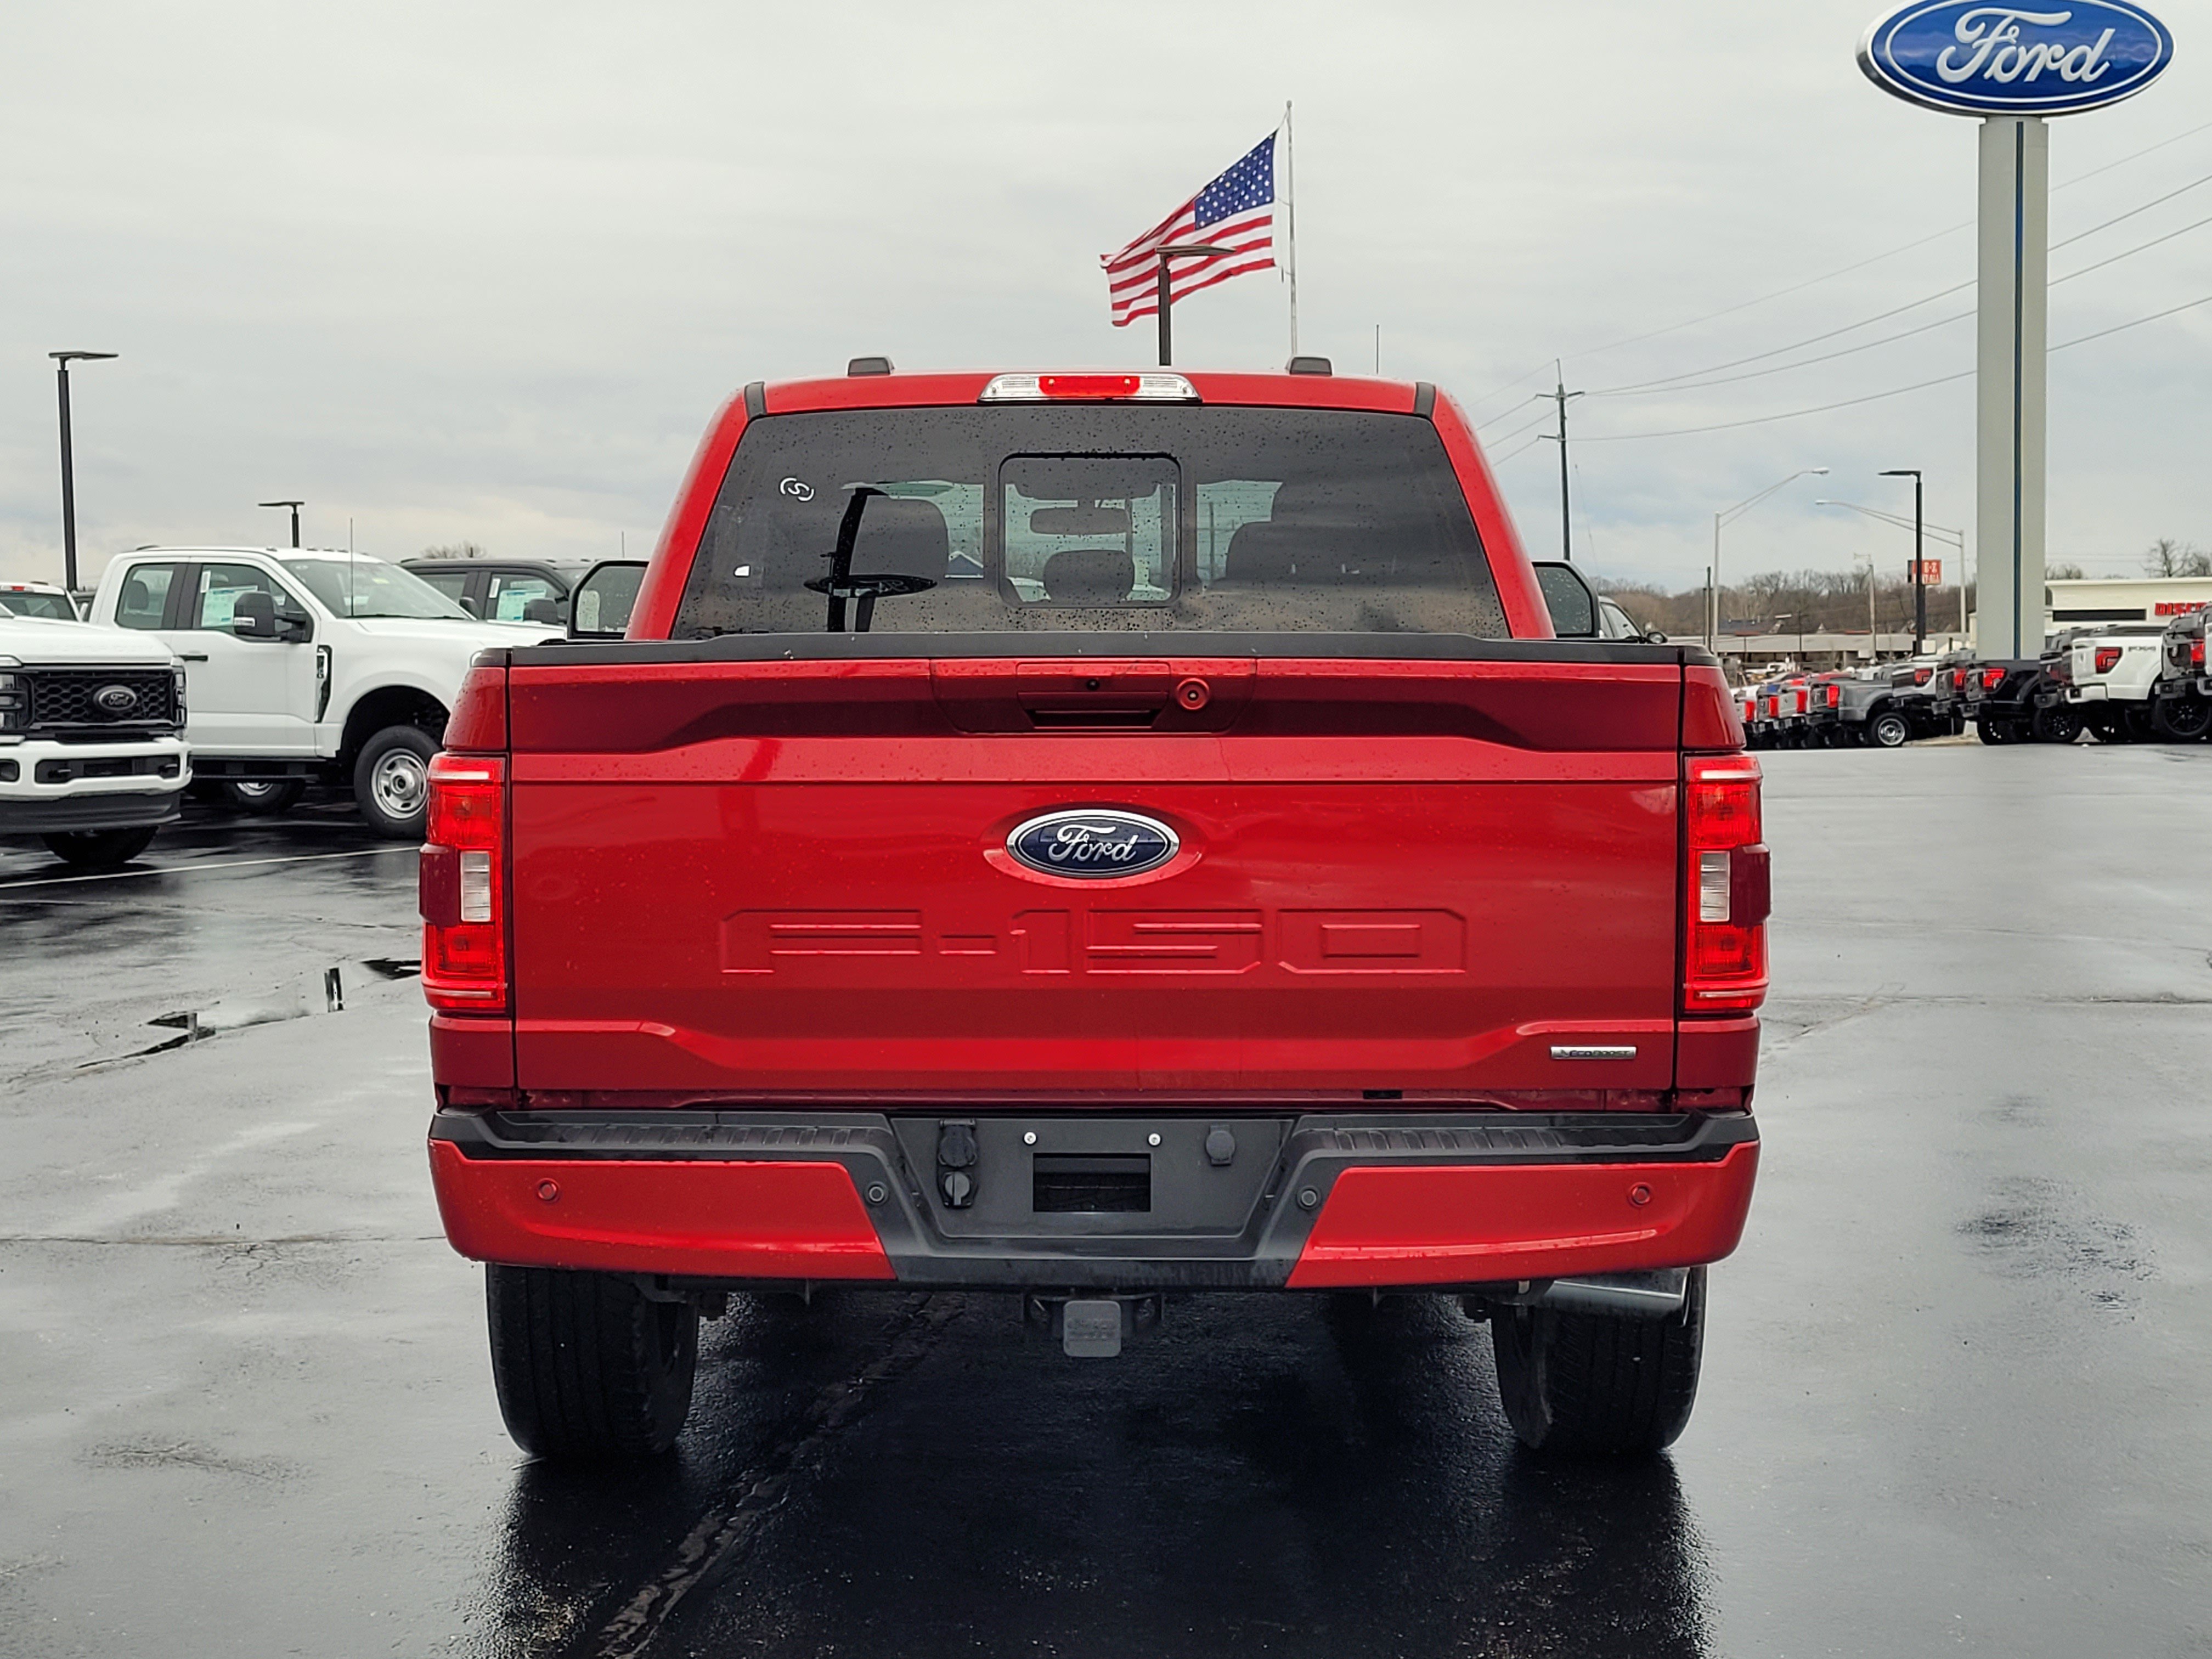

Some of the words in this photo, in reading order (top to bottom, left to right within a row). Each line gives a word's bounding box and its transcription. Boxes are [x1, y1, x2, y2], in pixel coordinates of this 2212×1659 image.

[1936, 8, 2115, 83] Ford
[1048, 824, 1139, 862] Ford
[720, 908, 1468, 974] F-150
